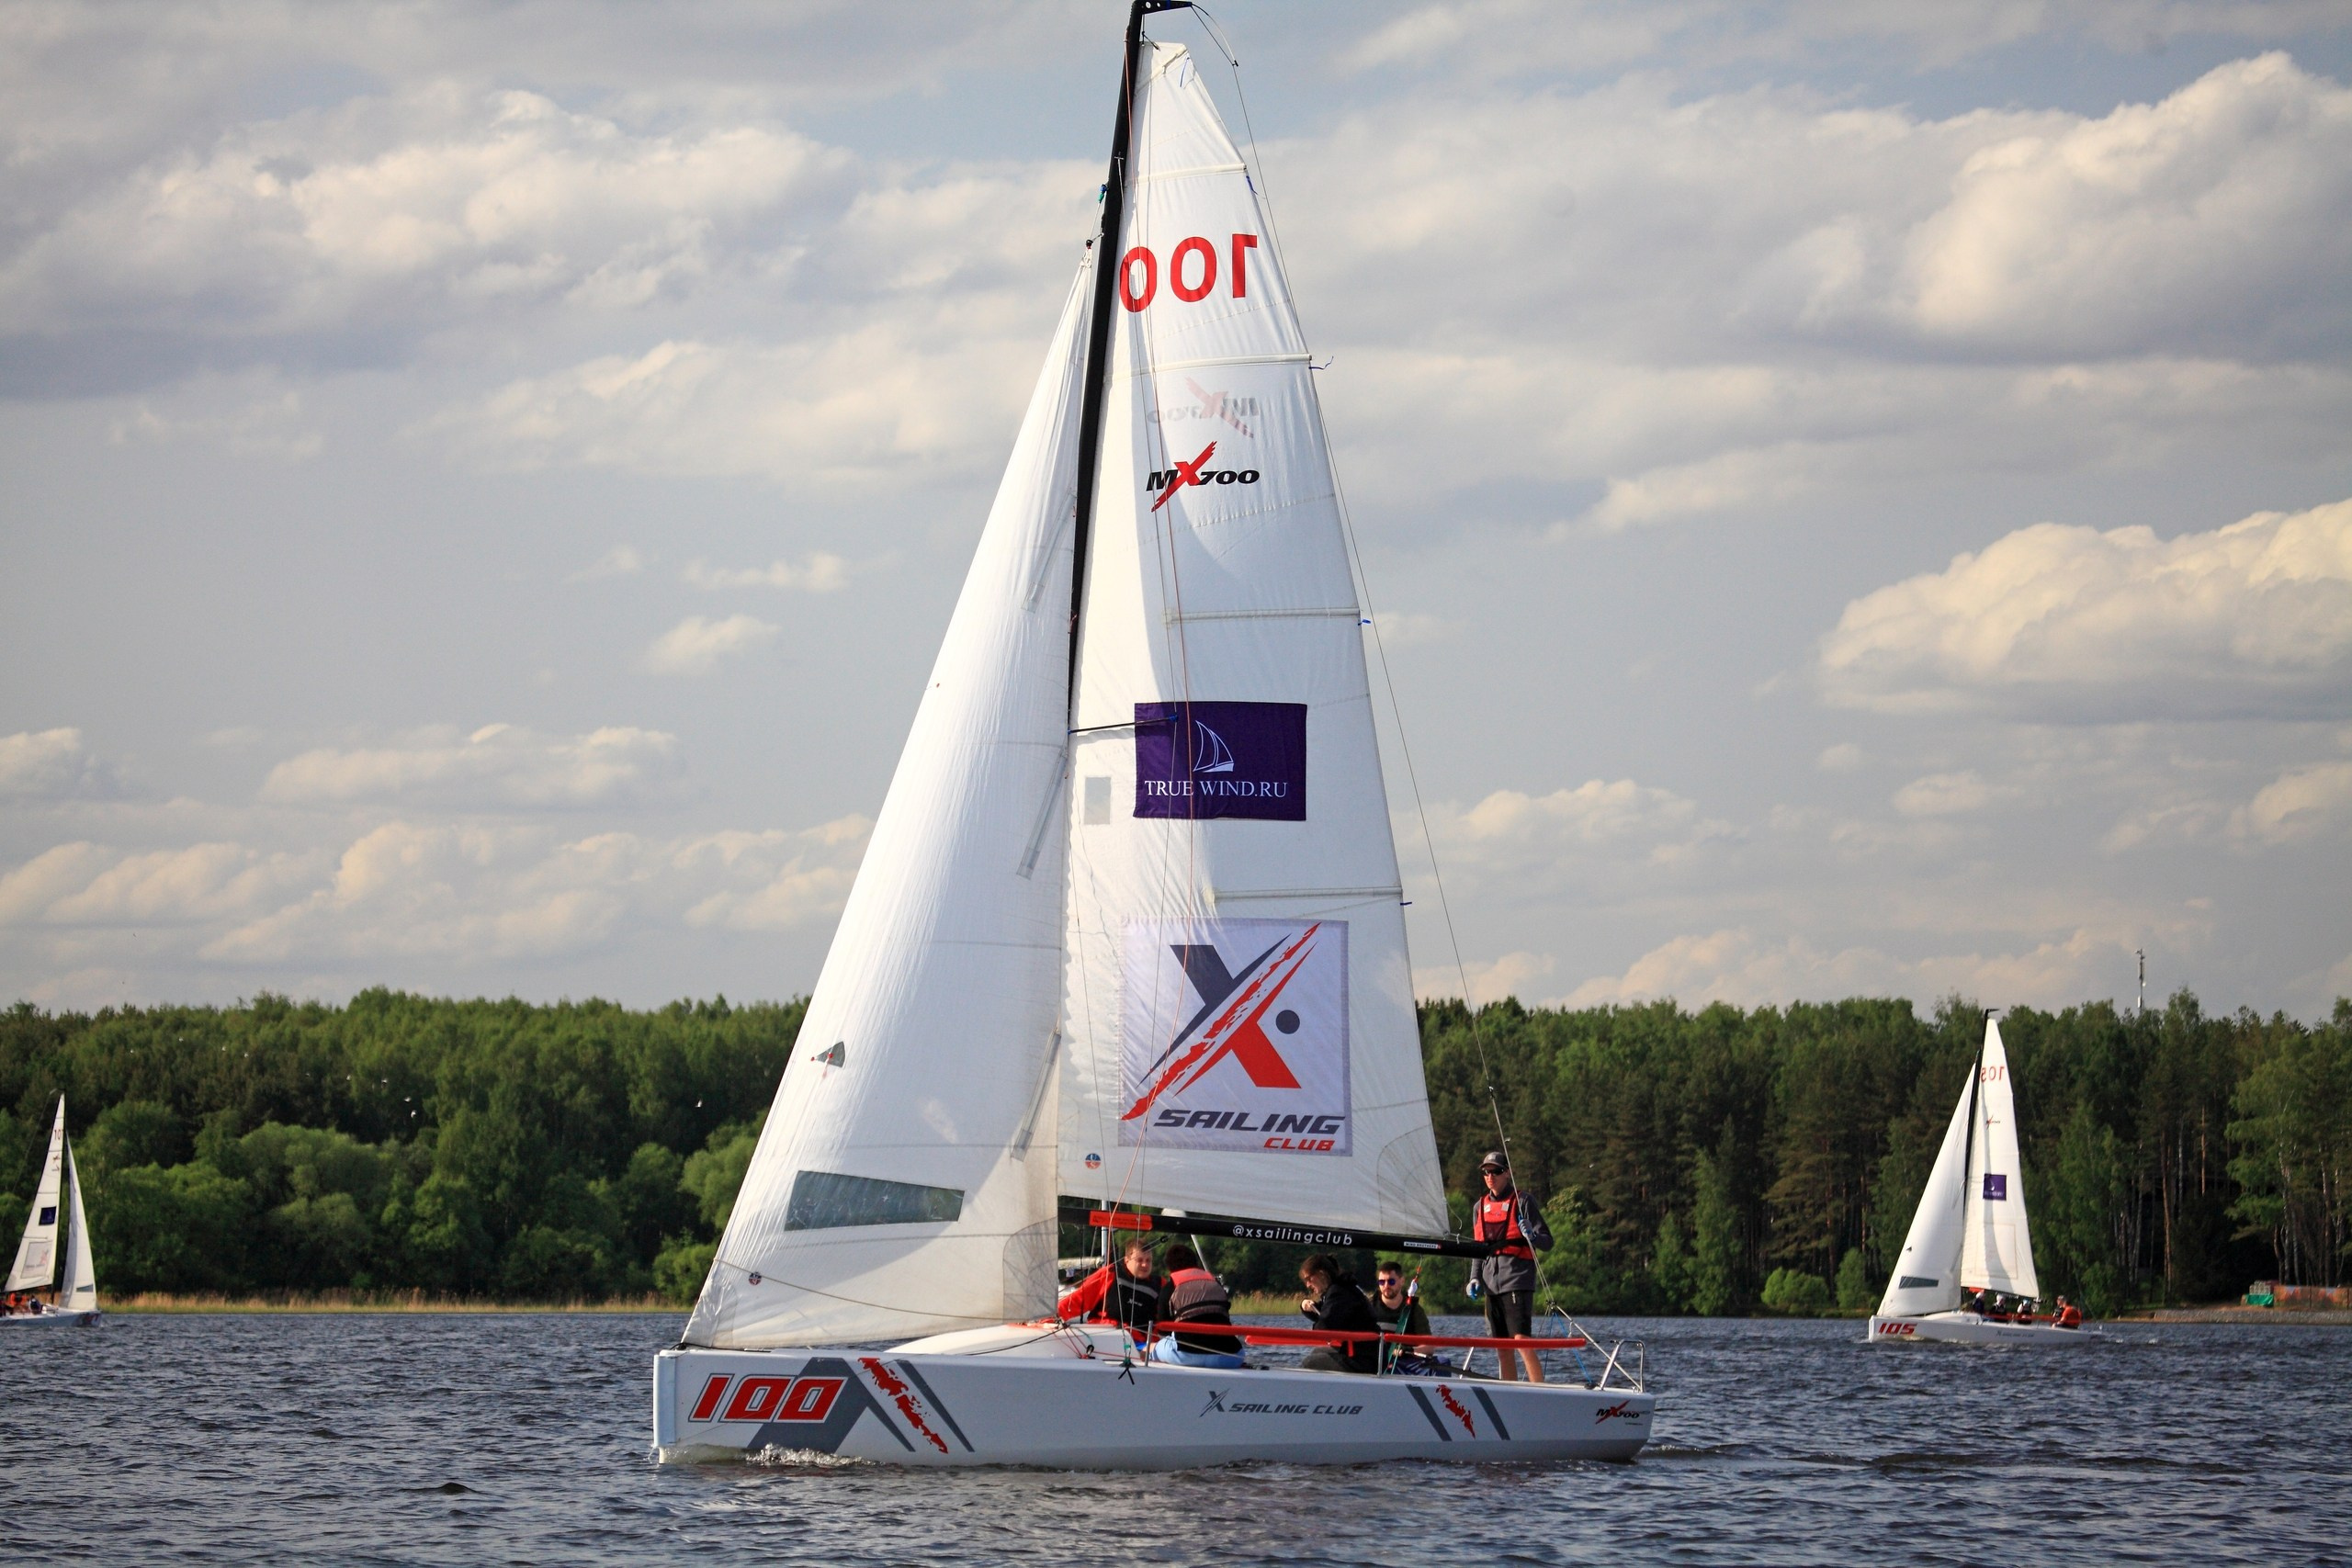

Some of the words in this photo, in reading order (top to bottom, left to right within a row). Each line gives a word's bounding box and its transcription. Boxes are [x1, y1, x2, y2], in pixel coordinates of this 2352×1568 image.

[1146, 441, 1260, 512] MX700
[1144, 780, 1193, 796] TRUE
[1199, 781, 1288, 798] WIND.RU
[1154, 1109, 1345, 1135] SAILING
[1264, 1137, 1336, 1152] CLUB
[1232, 1224, 1352, 1246] @xsailingclub
[1879, 1322, 1917, 1334] 105
[688, 1373, 848, 1423] 100
[1228, 1403, 1310, 1414] SAILING
[1313, 1404, 1363, 1416] CLUB
